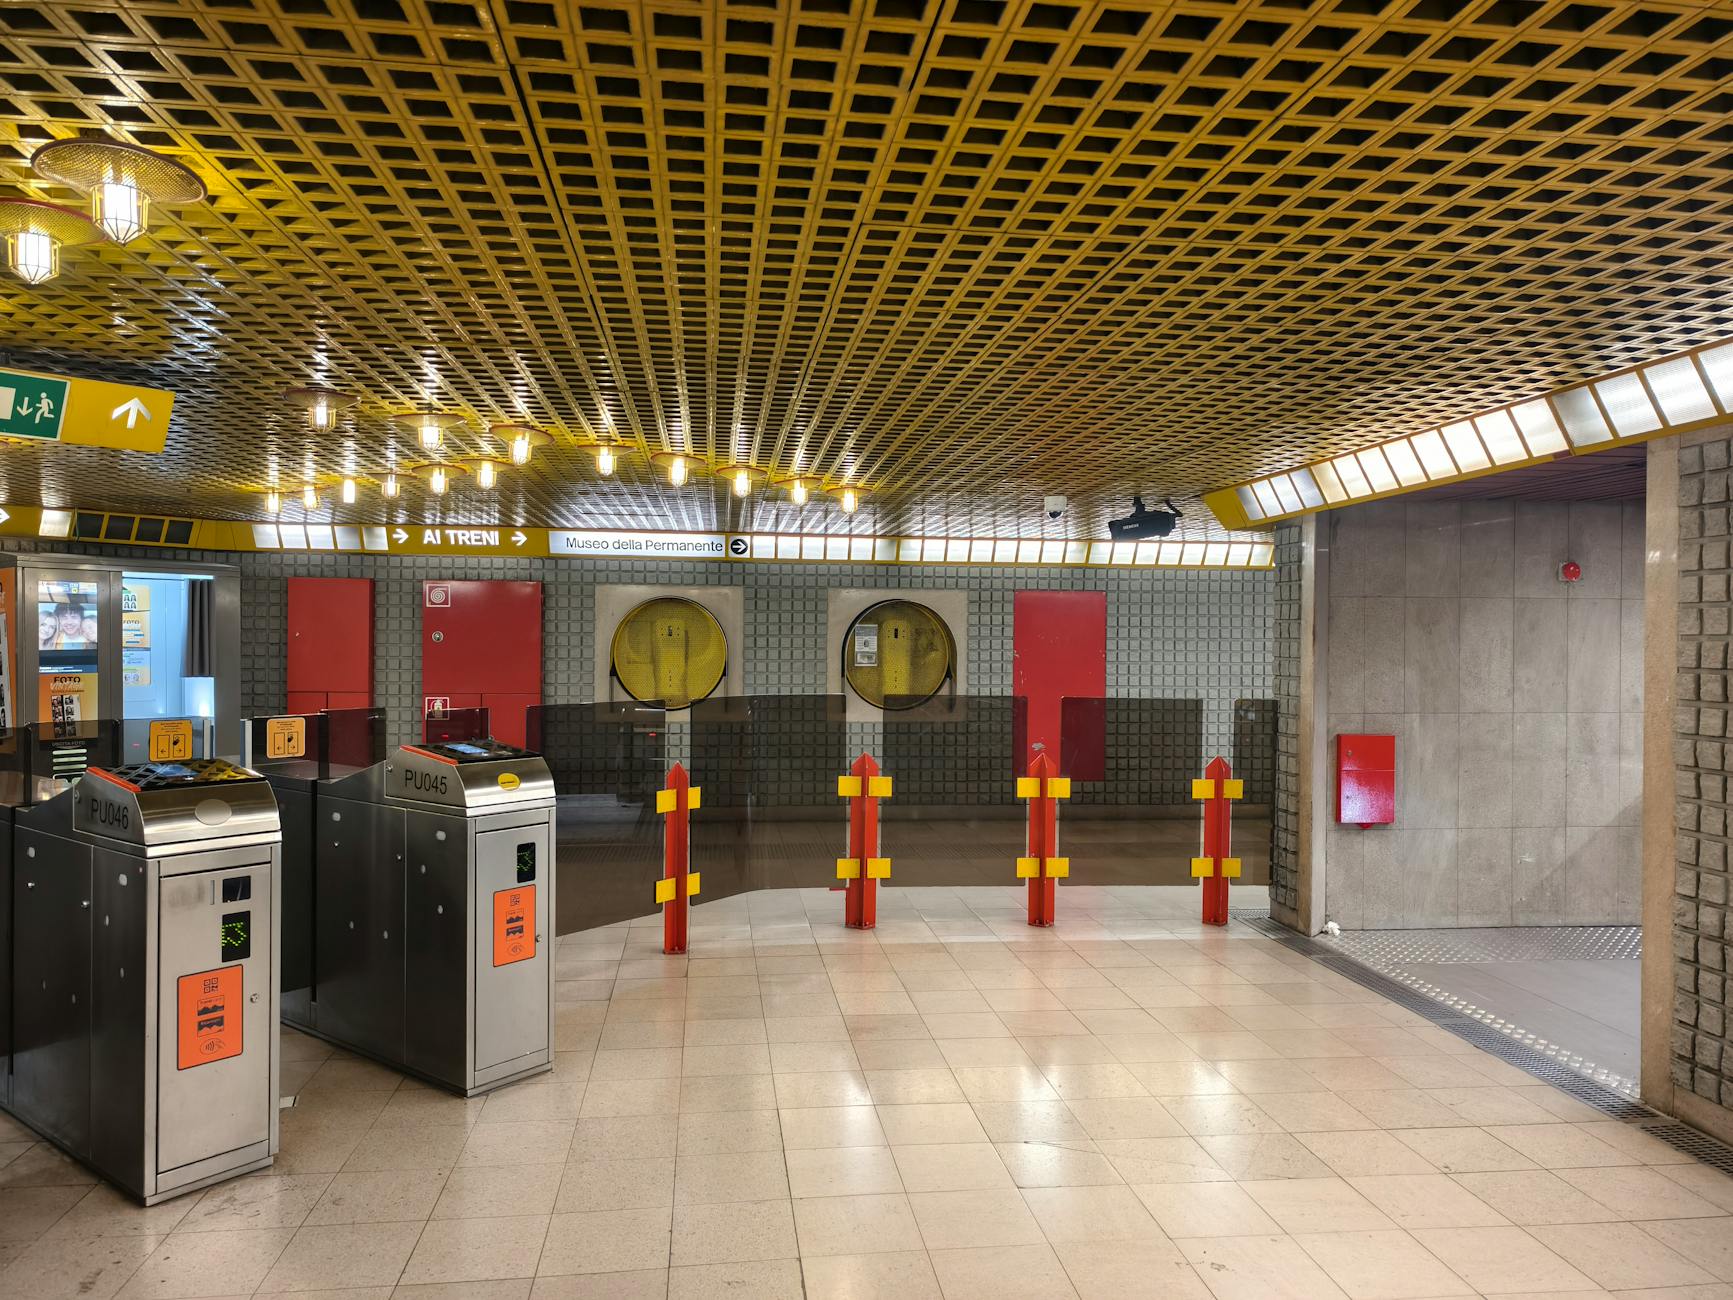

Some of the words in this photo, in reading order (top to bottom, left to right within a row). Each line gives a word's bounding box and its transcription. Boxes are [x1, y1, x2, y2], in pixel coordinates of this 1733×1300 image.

[423, 529, 441, 545] AI
[445, 529, 500, 546] TRENI
[566, 536, 609, 550] Museo
[612, 539, 643, 551] della
[645, 539, 723, 552] Permanente
[405, 769, 447, 795] PU045
[91, 798, 129, 830] PU046
